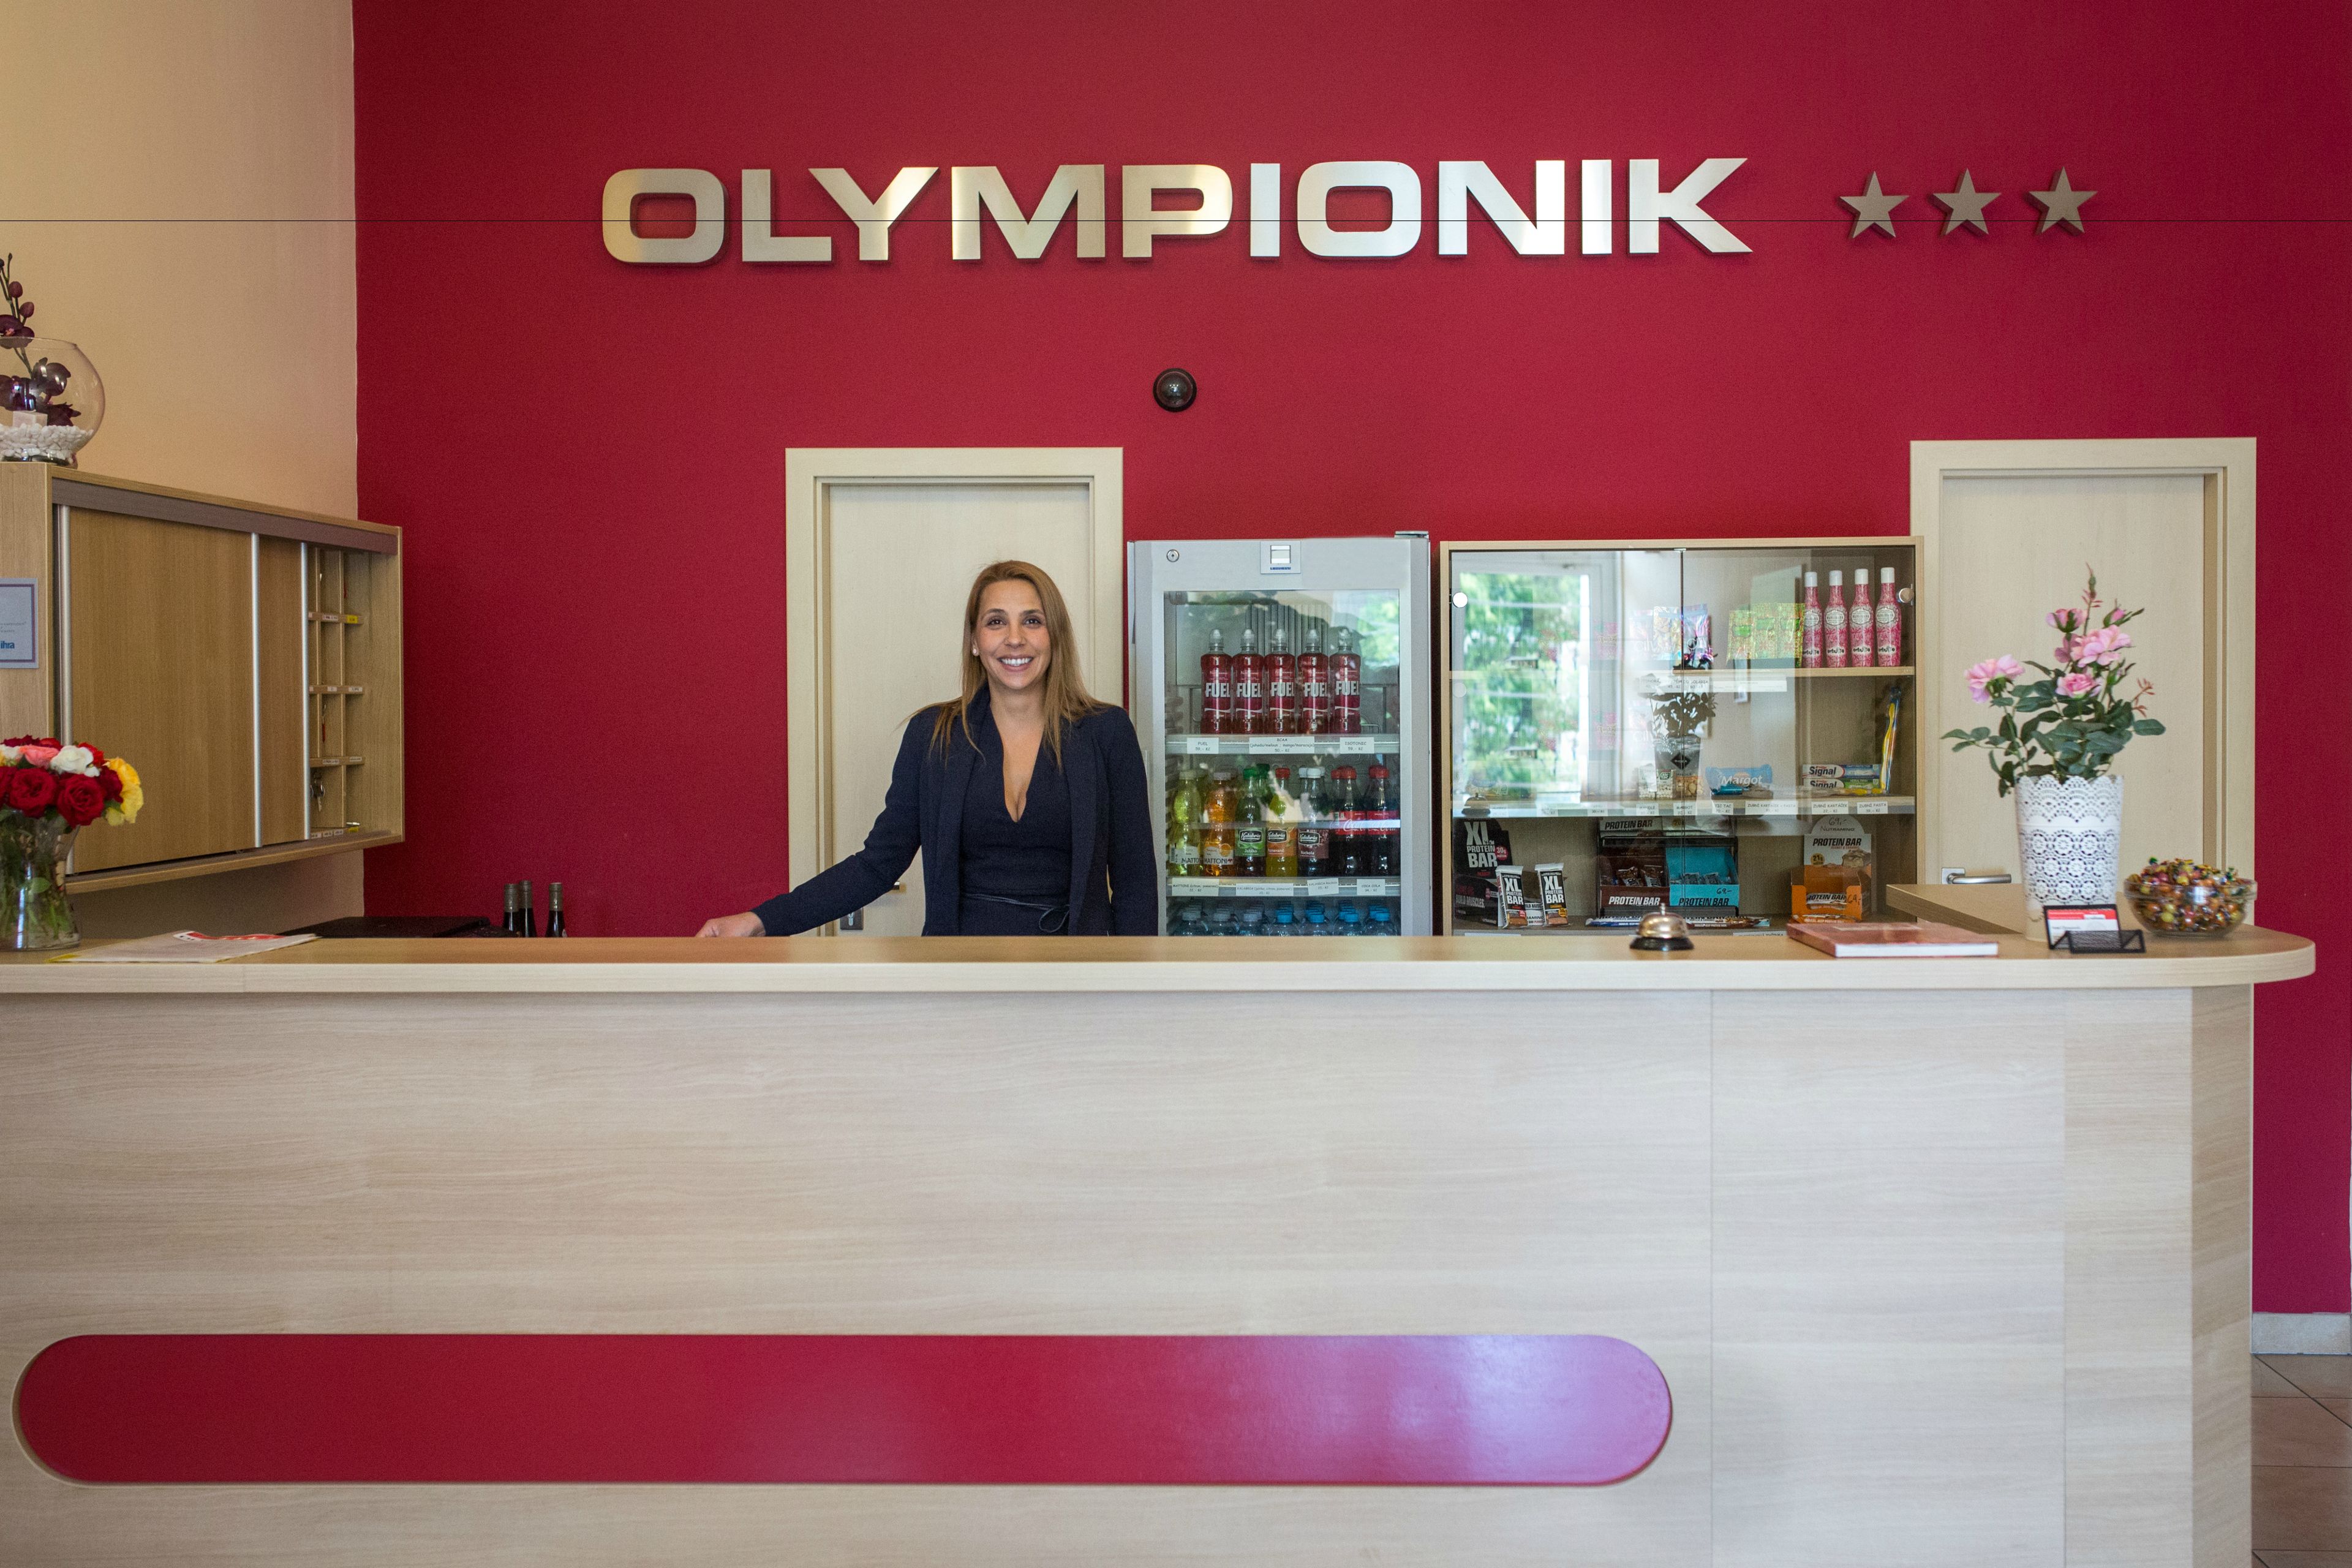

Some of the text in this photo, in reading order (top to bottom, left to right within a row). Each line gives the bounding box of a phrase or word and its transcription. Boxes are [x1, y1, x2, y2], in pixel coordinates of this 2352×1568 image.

[602, 158, 1752, 263] OLYMPIONIK
[1205, 682, 1231, 698] FUEL
[1236, 682, 1262, 698] FUEL
[1270, 682, 1295, 697] FUEL
[1304, 682, 1327, 698] FUEL
[1335, 680, 1359, 696] FUEL
[1809, 766, 1836, 777] Signal
[1721, 775, 1763, 786] Margot
[1604, 819, 1653, 830] PROTEIN BAR
[1464, 821, 1495, 845] XL
[1812, 838, 1862, 846] PROTEIN BAR
[1468, 853, 1498, 868] BAR
[1504, 878, 1522, 892] XL
[1544, 876, 1562, 890] XL
[1507, 895, 1524, 905] BAR
[1545, 894, 1564, 903] BAR
[1608, 896, 1661, 906] PROTEIN BAR
[1678, 897, 1730, 907] PROTEIN BAR
